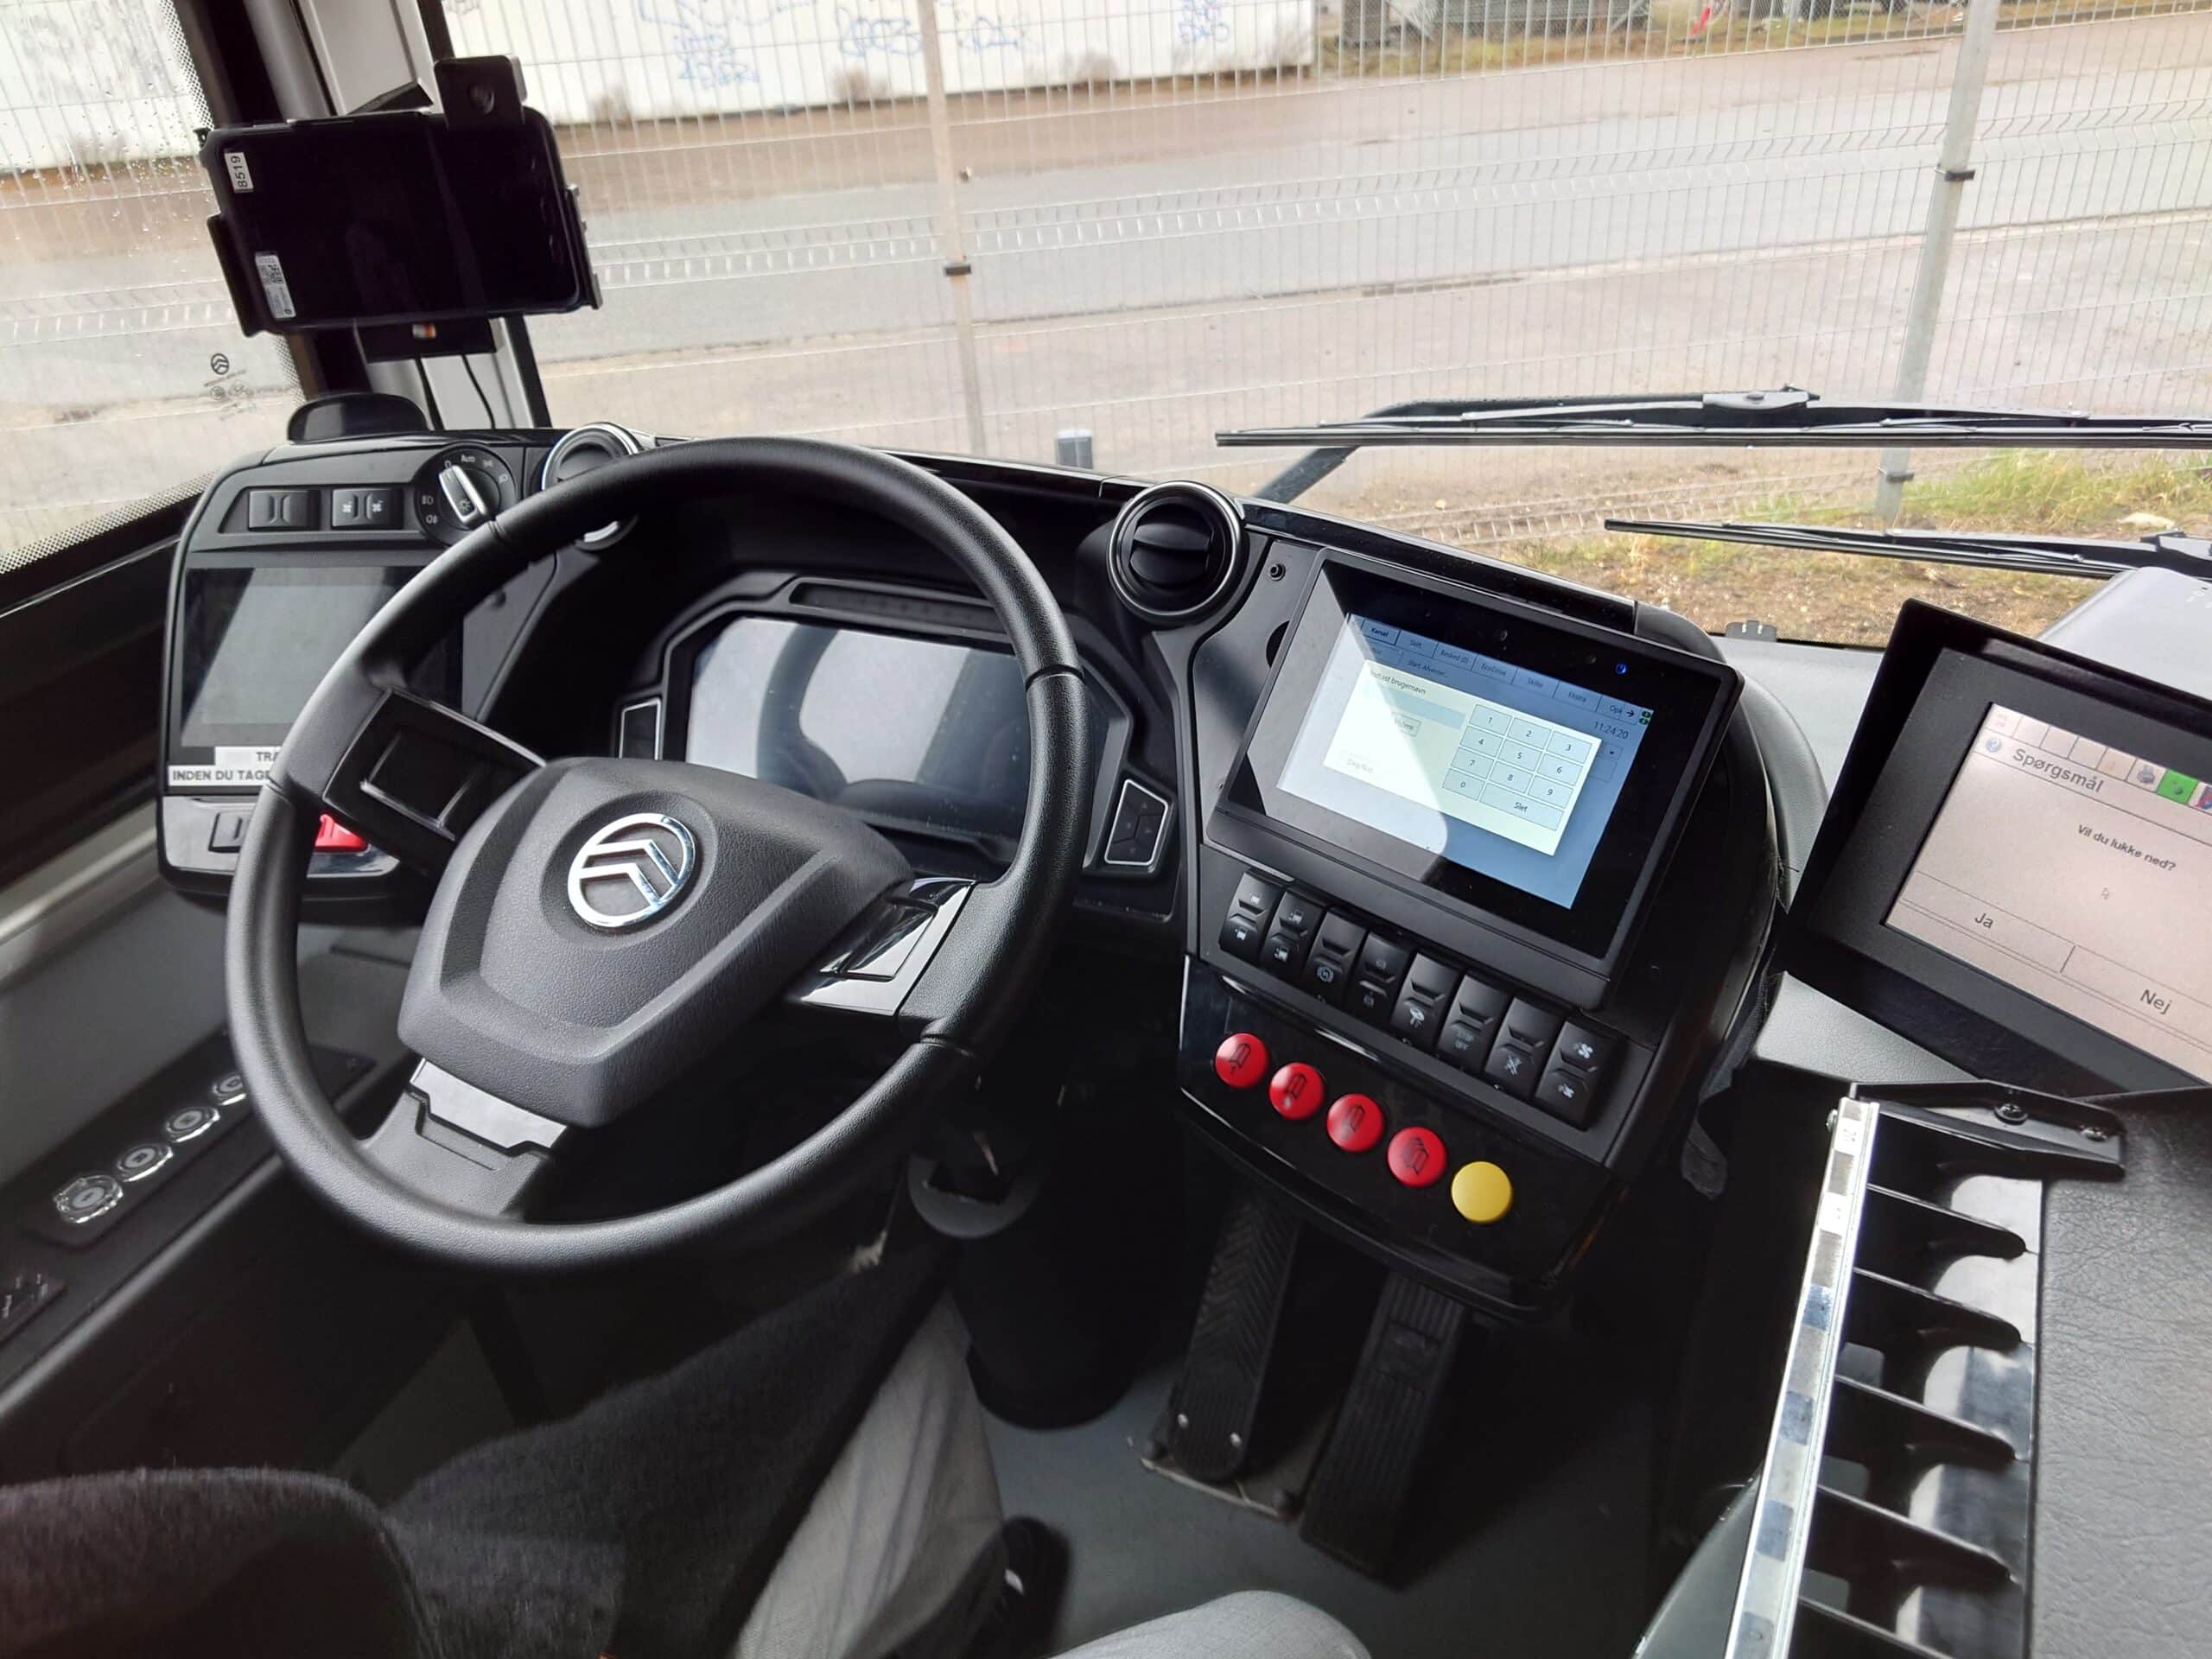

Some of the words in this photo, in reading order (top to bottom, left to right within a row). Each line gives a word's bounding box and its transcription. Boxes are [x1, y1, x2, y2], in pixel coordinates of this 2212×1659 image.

[231, 156, 248, 188] 8519
[1594, 721, 1629, 740] 11:24:20
[173, 770, 212, 781] INDEN
[215, 770, 233, 781] DU
[2012, 748, 2104, 793] Spørgsmål
[2078, 824, 2091, 837] Vil
[2094, 833, 2108, 845] du
[2110, 838, 2142, 858] lukke
[2144, 853, 2177, 872] ned?
[1974, 913, 1993, 928] Ja
[2139, 989, 2172, 1015] Nej
